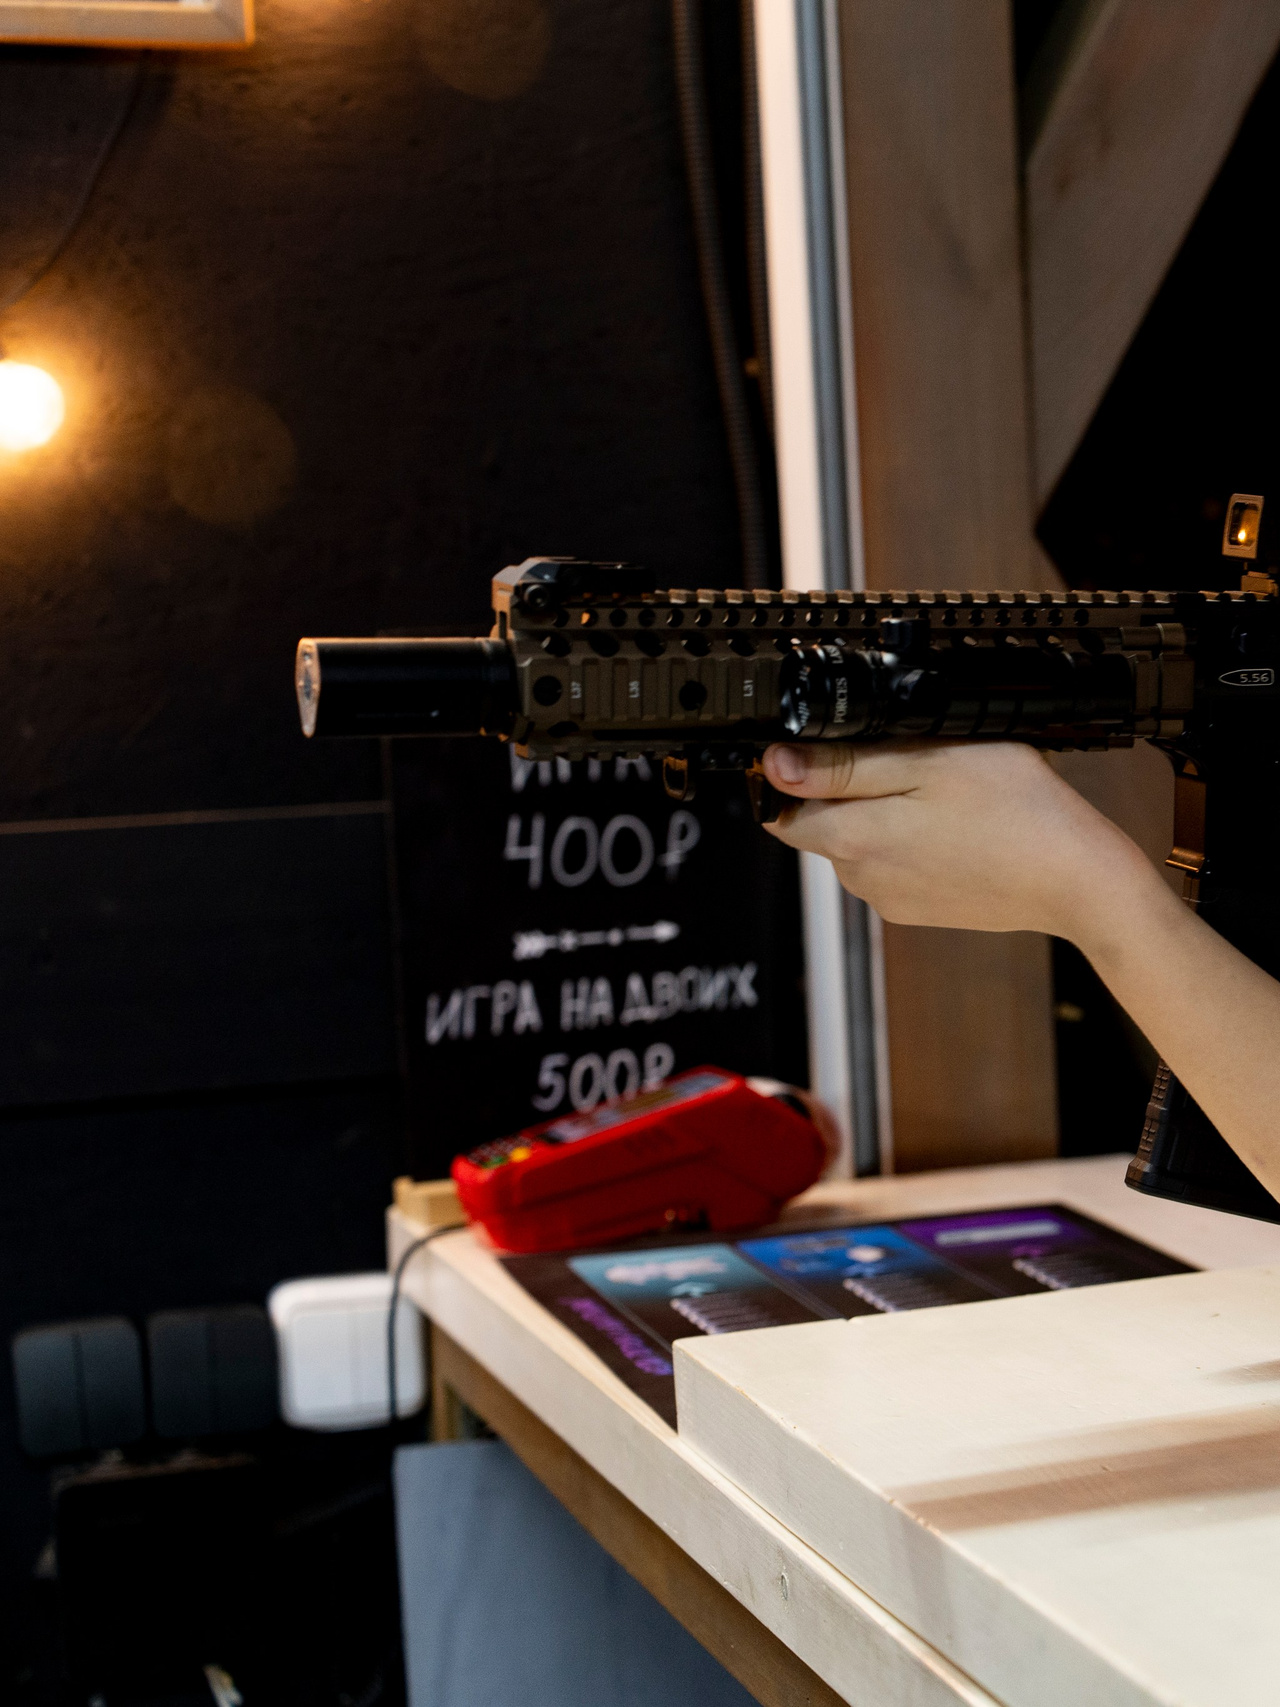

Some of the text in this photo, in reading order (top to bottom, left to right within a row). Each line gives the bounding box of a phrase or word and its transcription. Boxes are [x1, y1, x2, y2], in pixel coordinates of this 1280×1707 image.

[833, 677, 848, 723] FORCES
[1239, 672, 1270, 684] 5.56
[425, 960, 759, 1046] ИГРА НА ДВОИХ
